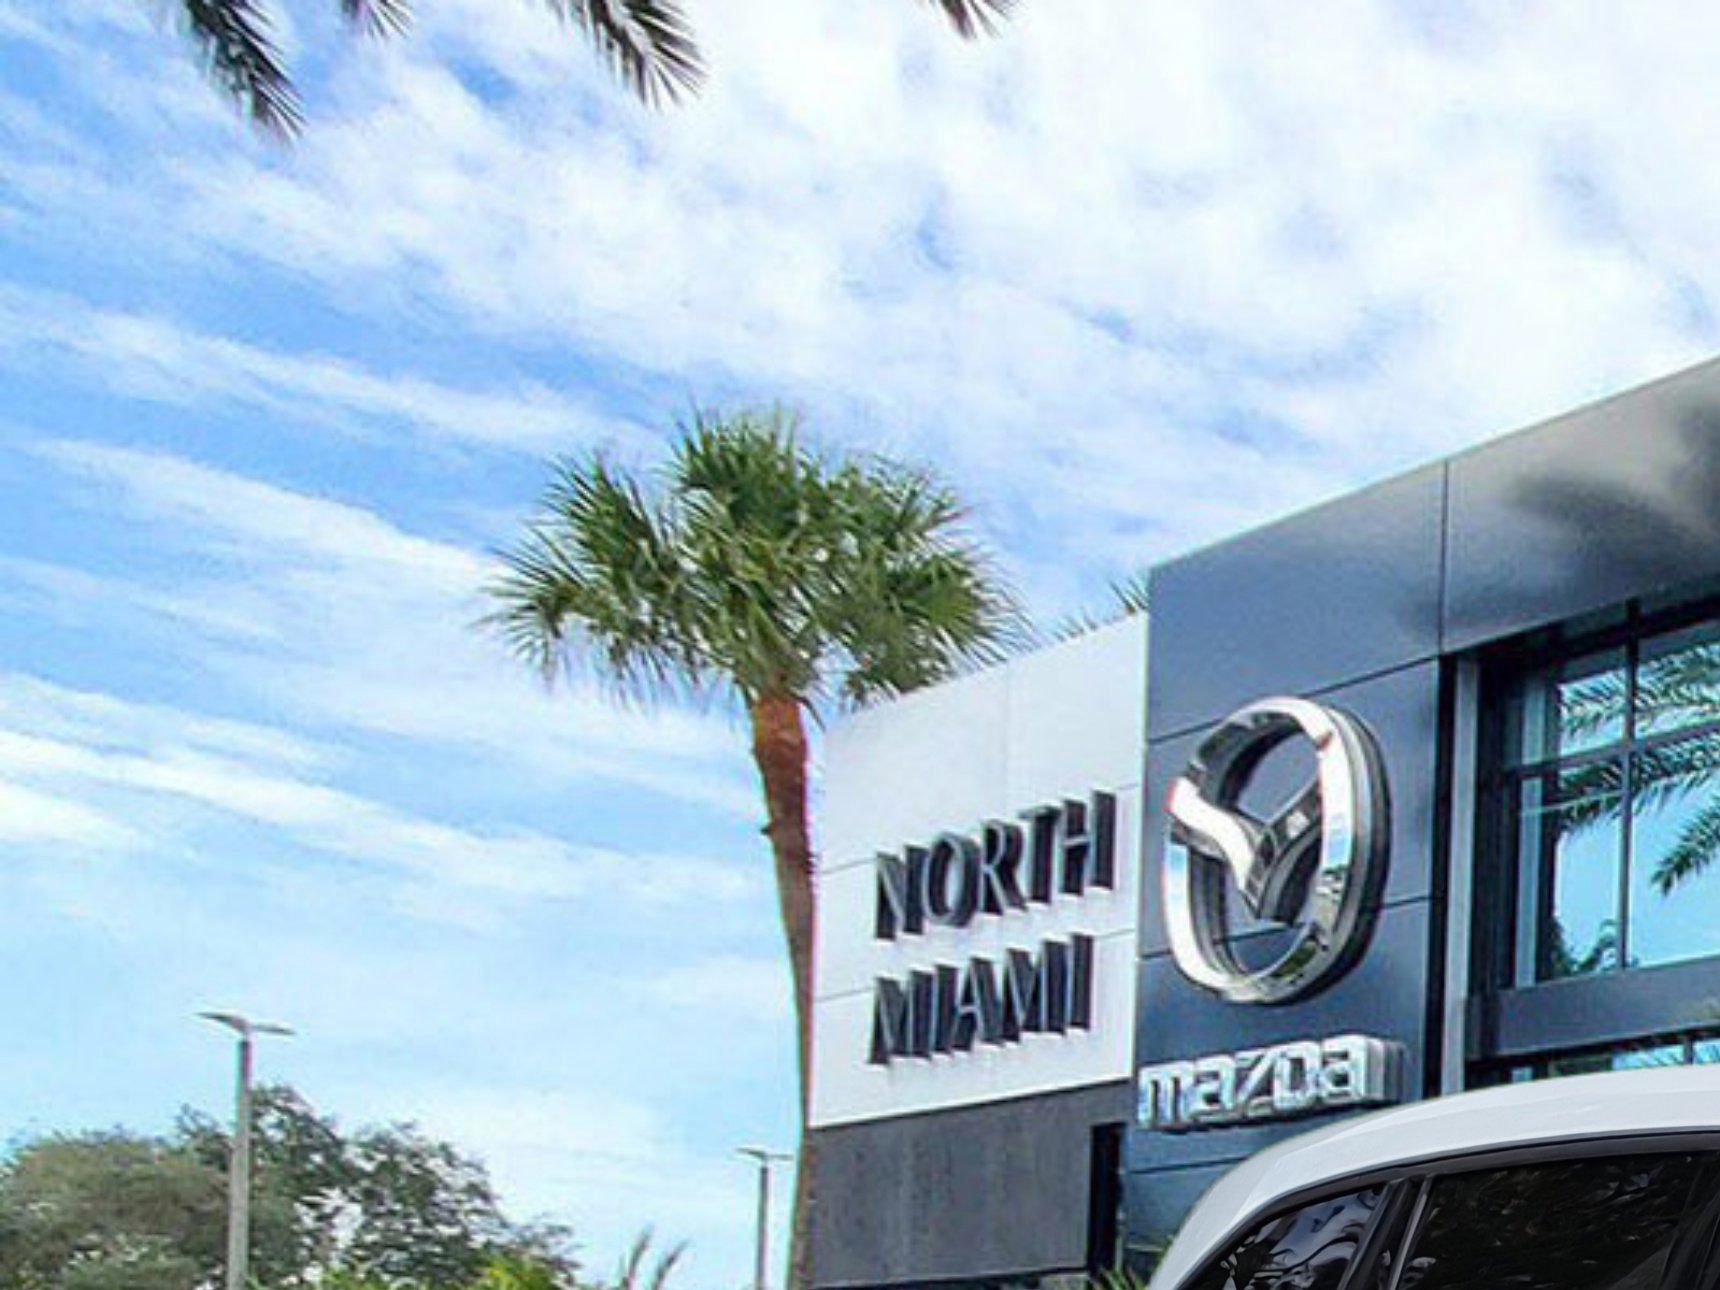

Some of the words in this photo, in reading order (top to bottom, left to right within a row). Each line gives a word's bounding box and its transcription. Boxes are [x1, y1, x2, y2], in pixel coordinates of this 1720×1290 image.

[875, 790, 1117, 940] NORTH
[869, 933, 1093, 1066] MIAMI
[1137, 1034, 1390, 1132] mazda
